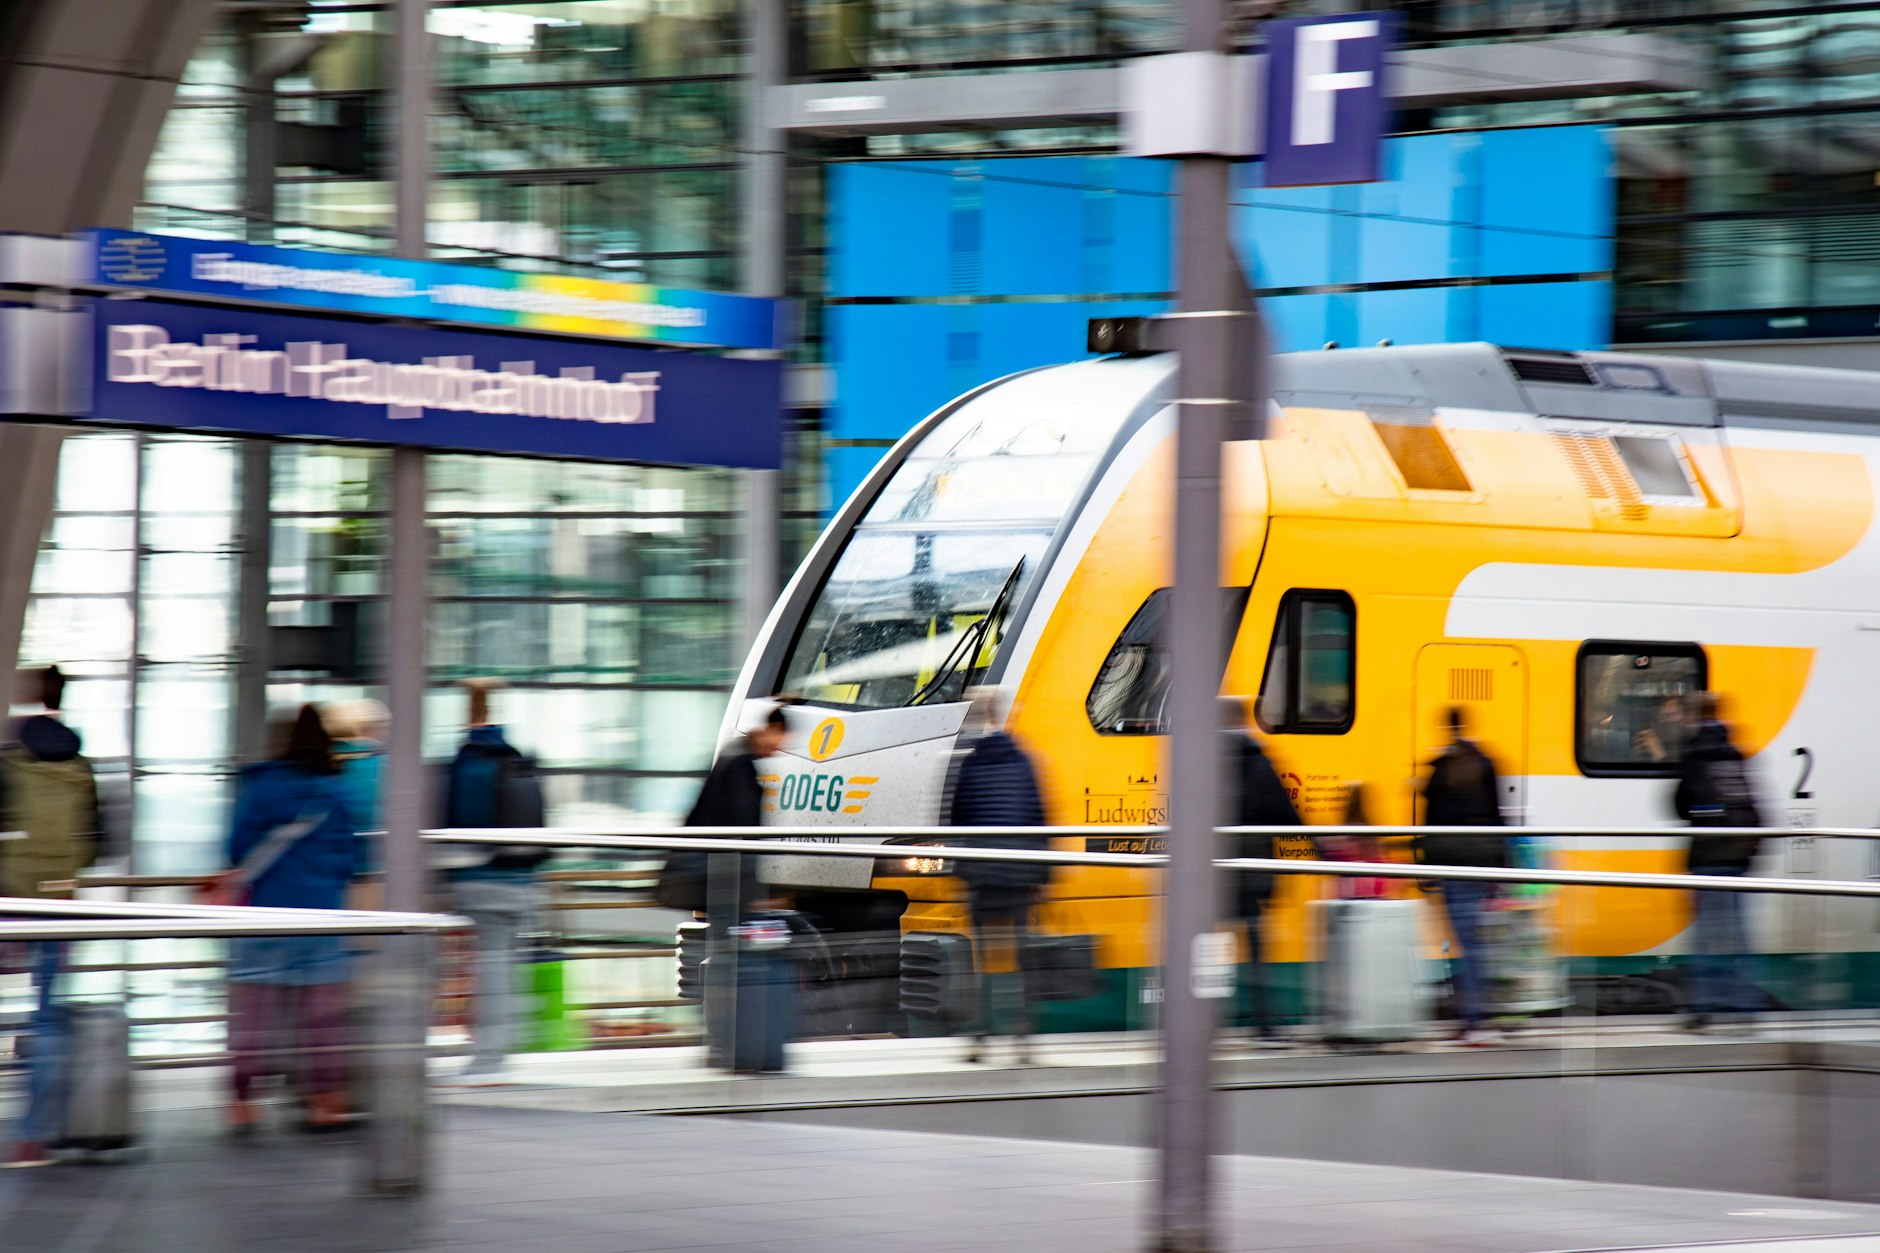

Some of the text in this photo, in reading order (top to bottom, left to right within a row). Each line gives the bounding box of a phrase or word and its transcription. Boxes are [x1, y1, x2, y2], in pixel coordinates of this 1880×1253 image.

[1290, 20, 1380, 146] F
[107, 324, 661, 424] Berlin Hauptbahnhof
[819, 724, 834, 755] 1
[1792, 747, 1815, 799] 2
[780, 774, 844, 812] ODEG
[1085, 797, 1170, 827] Ludwigsl
[1108, 838, 1168, 854] Lust auf Leb
[1279, 846, 1320, 860] Vorpom
